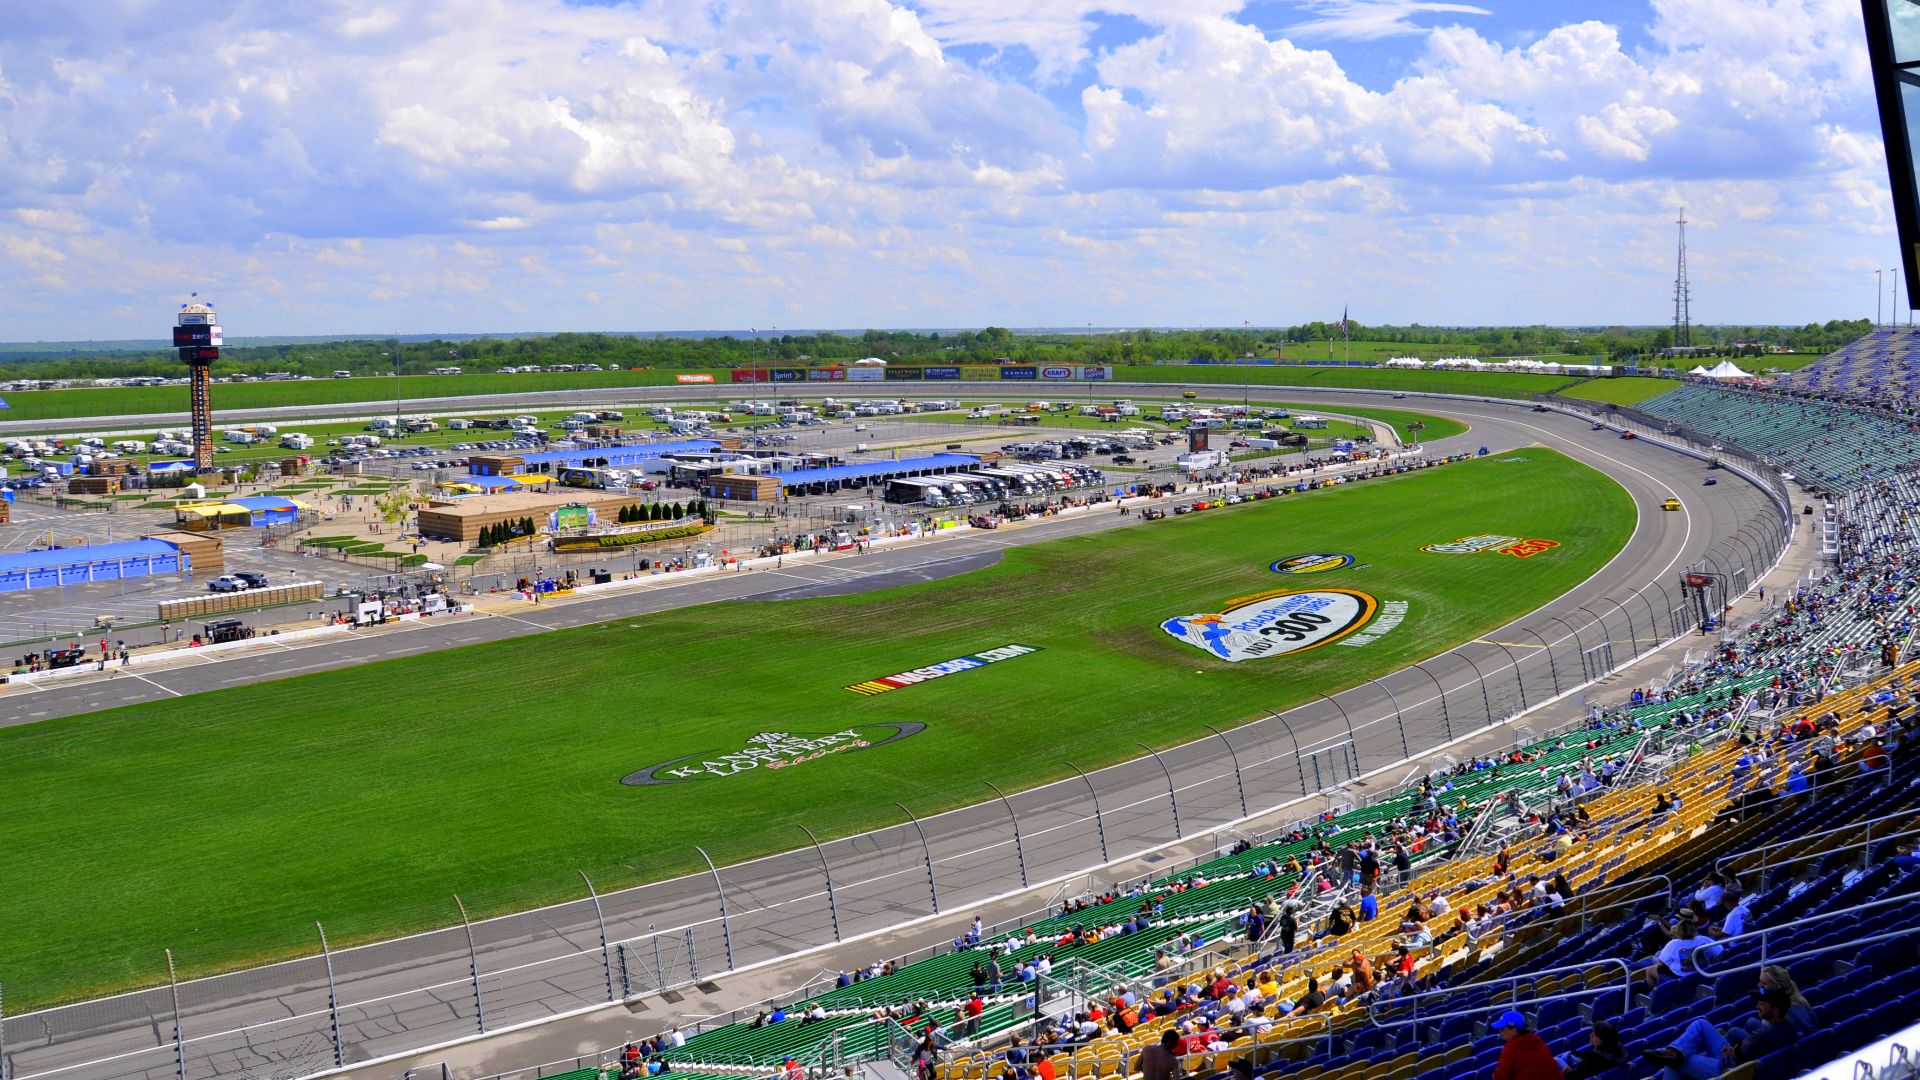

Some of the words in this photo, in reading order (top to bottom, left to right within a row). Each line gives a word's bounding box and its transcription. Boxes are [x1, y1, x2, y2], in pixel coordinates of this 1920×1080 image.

[774, 372, 793, 380] Sprint
[1047, 369, 1067, 377] KRAFT
[1497, 538, 1562, 559] 250
[1231, 613, 1276, 632] ROAD
[1259, 612, 1332, 642] 300
[1241, 637, 1279, 656] INDY
[664, 736, 809, 778] KANSAS
[705, 728, 864, 778] LOTTERY
